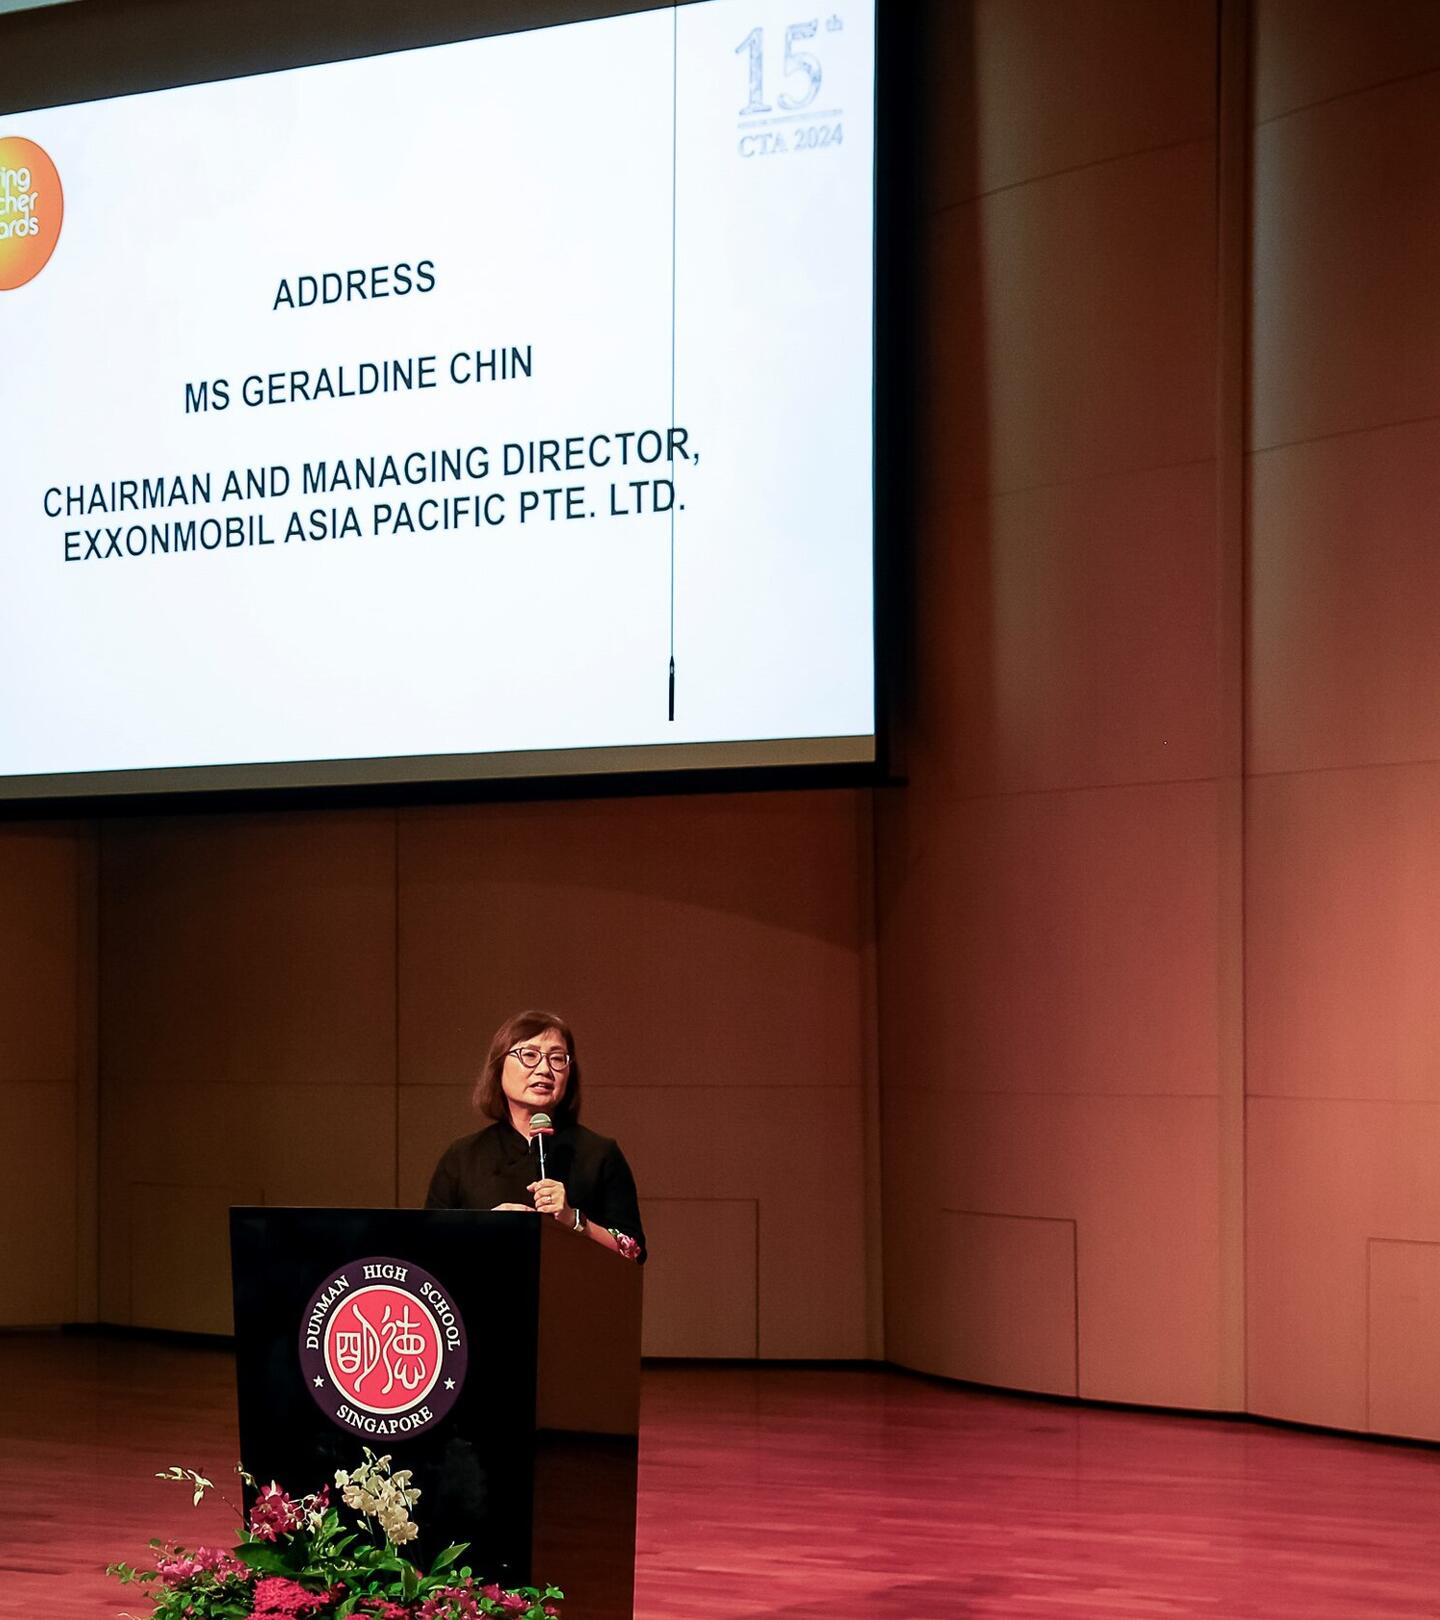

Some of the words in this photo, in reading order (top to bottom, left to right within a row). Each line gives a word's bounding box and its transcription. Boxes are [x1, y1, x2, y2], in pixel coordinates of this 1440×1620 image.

[739, 133, 788, 158] CTA
[794, 123, 843, 151] 2024
[272, 260, 436, 310] ADDRESS
[185, 379, 230, 413] MS
[242, 355, 437, 407] GERALDINE
[450, 345, 532, 384] CHIN
[44, 472, 211, 517] CHAIRMAN
[222, 465, 290, 502] AND
[303, 446, 489, 494] MANAGING
[503, 427, 699, 476] DIRECTOR,
[64, 514, 275, 562] EXXONMOBIL
[284, 506, 362, 543] ASIA
[374, 493, 505, 535] PACIFIC
[520, 486, 596, 523] PTE.
[610, 479, 685, 516] LTD.
[306, 1275, 350, 1350] DUNMAN
[362, 1264, 408, 1283] HIGH
[420, 1281, 461, 1352] SCHOOL
[336, 1404, 433, 1434] SINGAPORE
